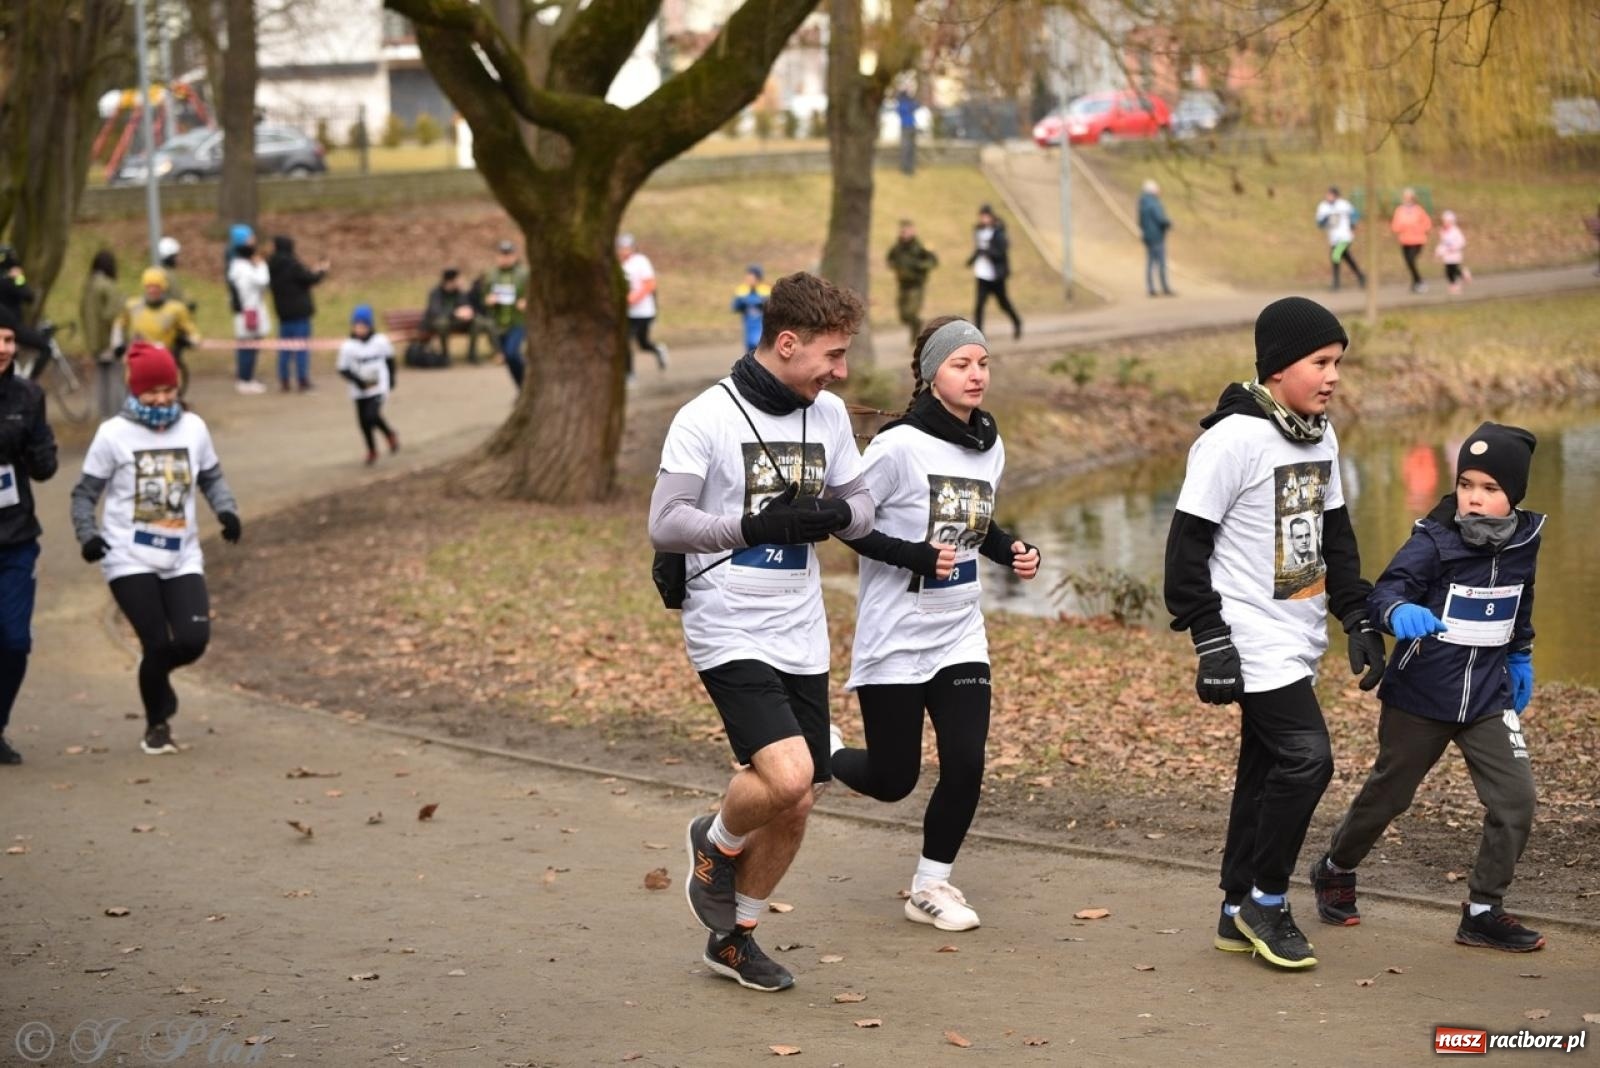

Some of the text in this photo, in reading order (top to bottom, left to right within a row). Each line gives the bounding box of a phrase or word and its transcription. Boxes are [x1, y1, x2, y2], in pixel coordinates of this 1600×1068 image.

[765, 548, 784, 564] 74
[1485, 602, 1495, 616] 8
[953, 678, 977, 686] GYM
